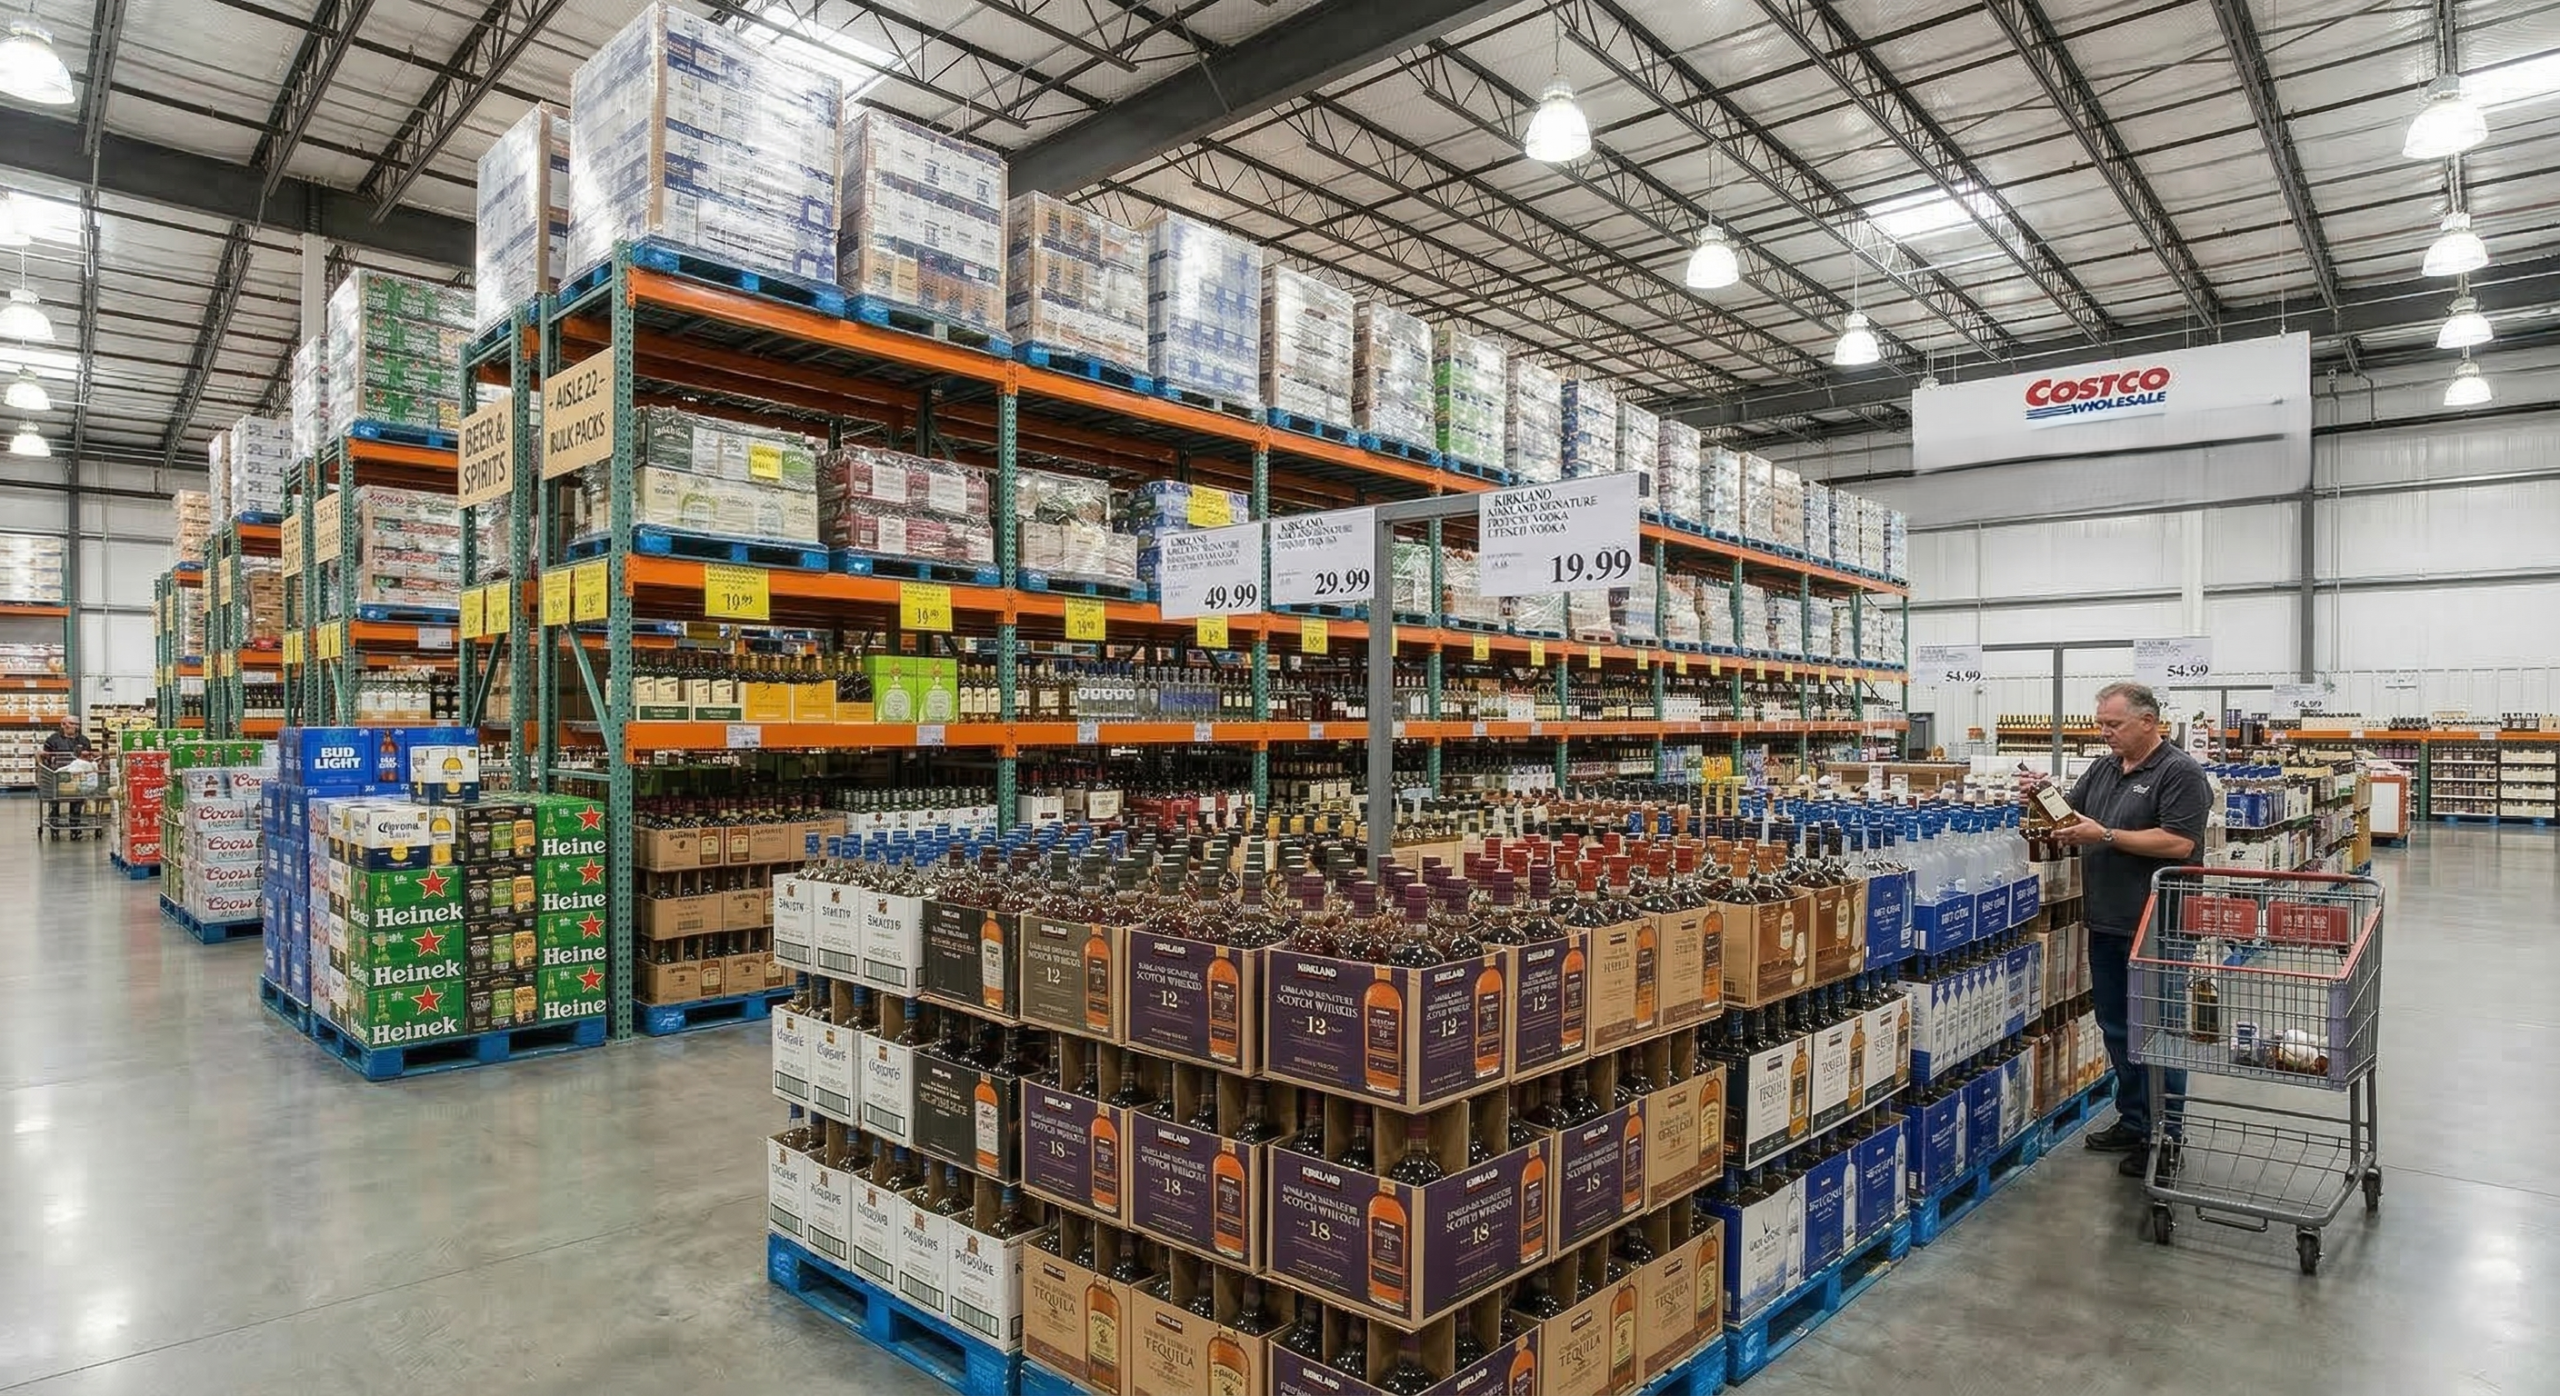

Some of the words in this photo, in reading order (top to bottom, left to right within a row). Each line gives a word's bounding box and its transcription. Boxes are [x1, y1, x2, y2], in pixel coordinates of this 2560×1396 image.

[555, 374, 584, 411] AISLE
[585, 369, 598, 401] 22
[2026, 367, 2170, 407] COSTCO
[464, 417, 494, 458] BEER
[495, 411, 506, 444] &
[550, 419, 574, 456] BULK
[575, 411, 606, 447] PACKS
[463, 450, 506, 497] SPIRITS
[1551, 549, 1632, 584] 19.99
[1314, 568, 1371, 596] 29.99
[1204, 583, 1257, 610] 49.99
[2167, 664, 2209, 677] 54.99
[314, 757, 361, 769] LIGHT
[321, 747, 355, 758] BUD
[375, 902, 465, 928] Heinek
[373, 959, 461, 987] Heinek
[1046, 967, 1061, 985] 12
[1161, 990, 1178, 1008] 12
[371, 1016, 458, 1045] Heinek
[1305, 1015, 1326, 1035] 12
[1050, 1140, 1065, 1158] 18
[1164, 1177, 1181, 1196] 18
[1586, 1172, 1600, 1193] 18
[1310, 1219, 1331, 1241] 18
[1472, 1222, 1490, 1245] 18
[1033, 1285, 1076, 1316] TEQUILA
[1143, 1335, 1195, 1370] TEQUILA
[1559, 1334, 1601, 1368] TEQUILA
